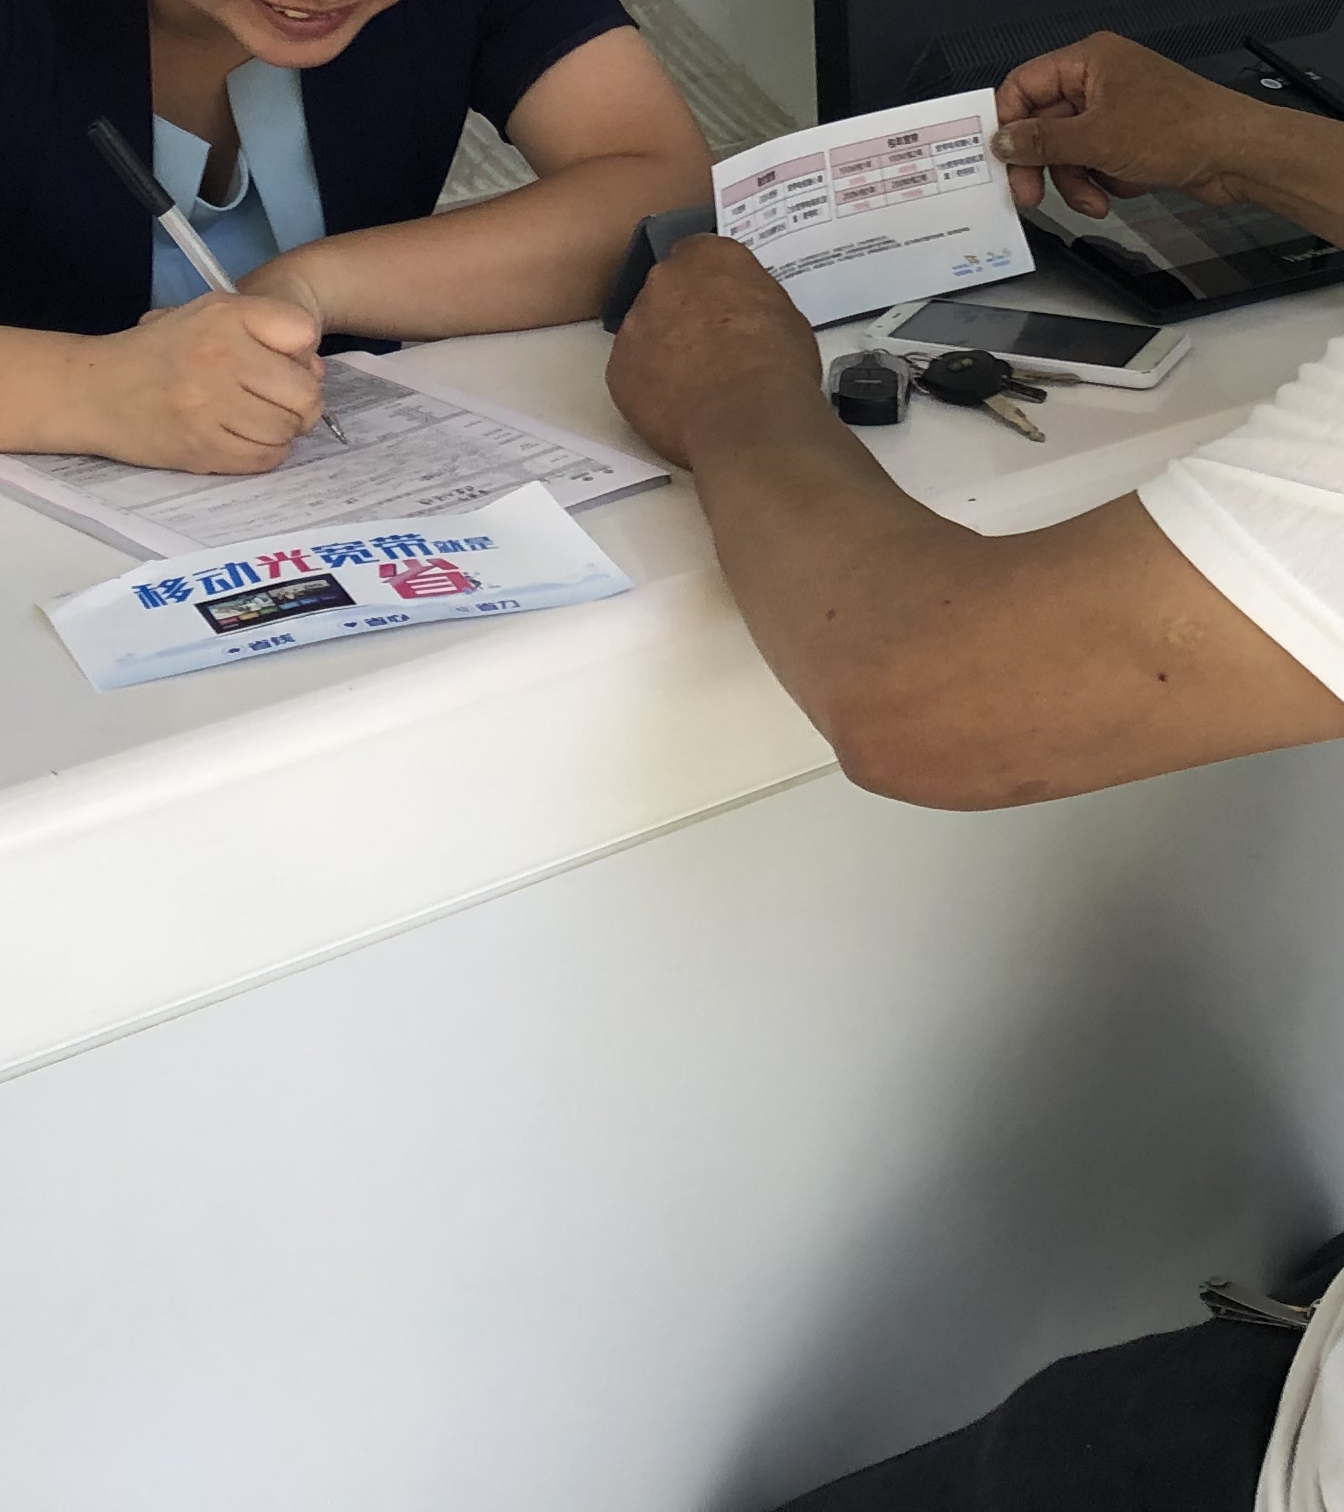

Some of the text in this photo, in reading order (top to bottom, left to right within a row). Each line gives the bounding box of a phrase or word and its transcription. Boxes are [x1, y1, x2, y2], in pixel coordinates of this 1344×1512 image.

[379, 558, 476, 599] 省
[248, 599, 521, 651] 省钱 省心 省力
